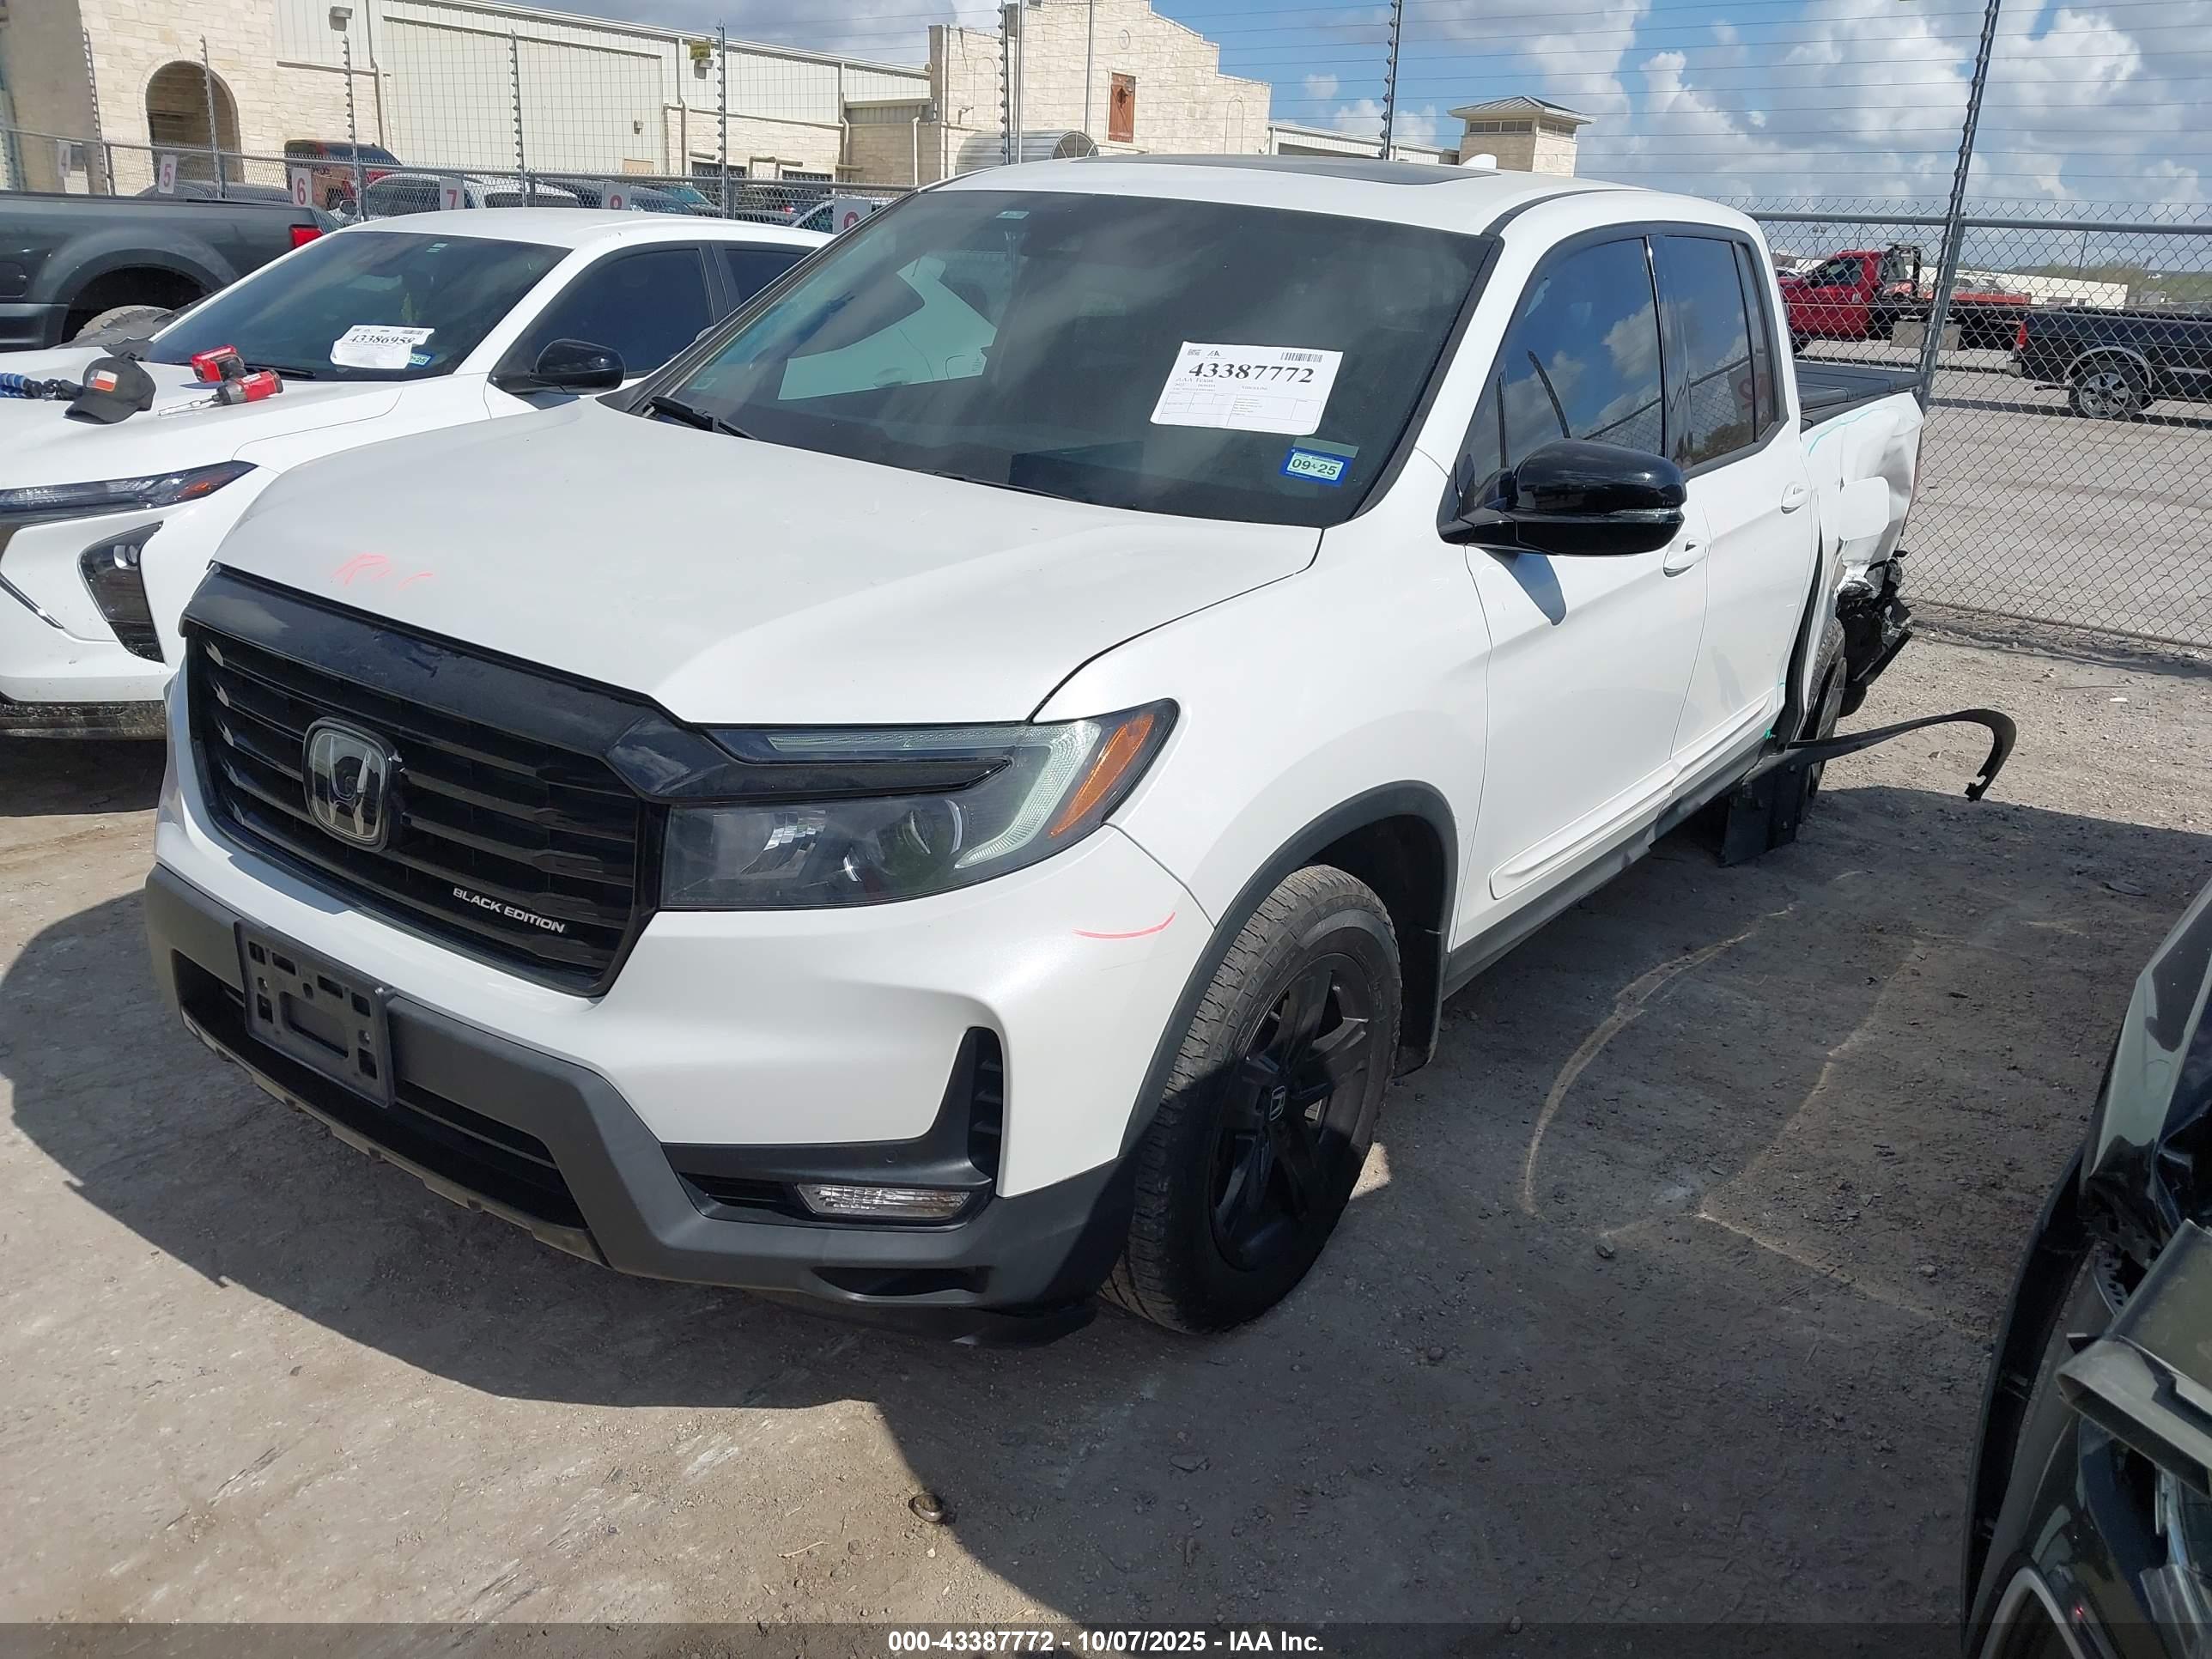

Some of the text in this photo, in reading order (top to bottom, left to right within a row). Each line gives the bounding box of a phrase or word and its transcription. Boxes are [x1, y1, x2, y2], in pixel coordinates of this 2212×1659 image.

[163, 163, 172, 187] 5
[296, 178, 307, 205] 6
[446, 189, 458, 209] 7
[1188, 362, 1315, 384] 43387772
[453, 887, 566, 933] BLACK EDITION
